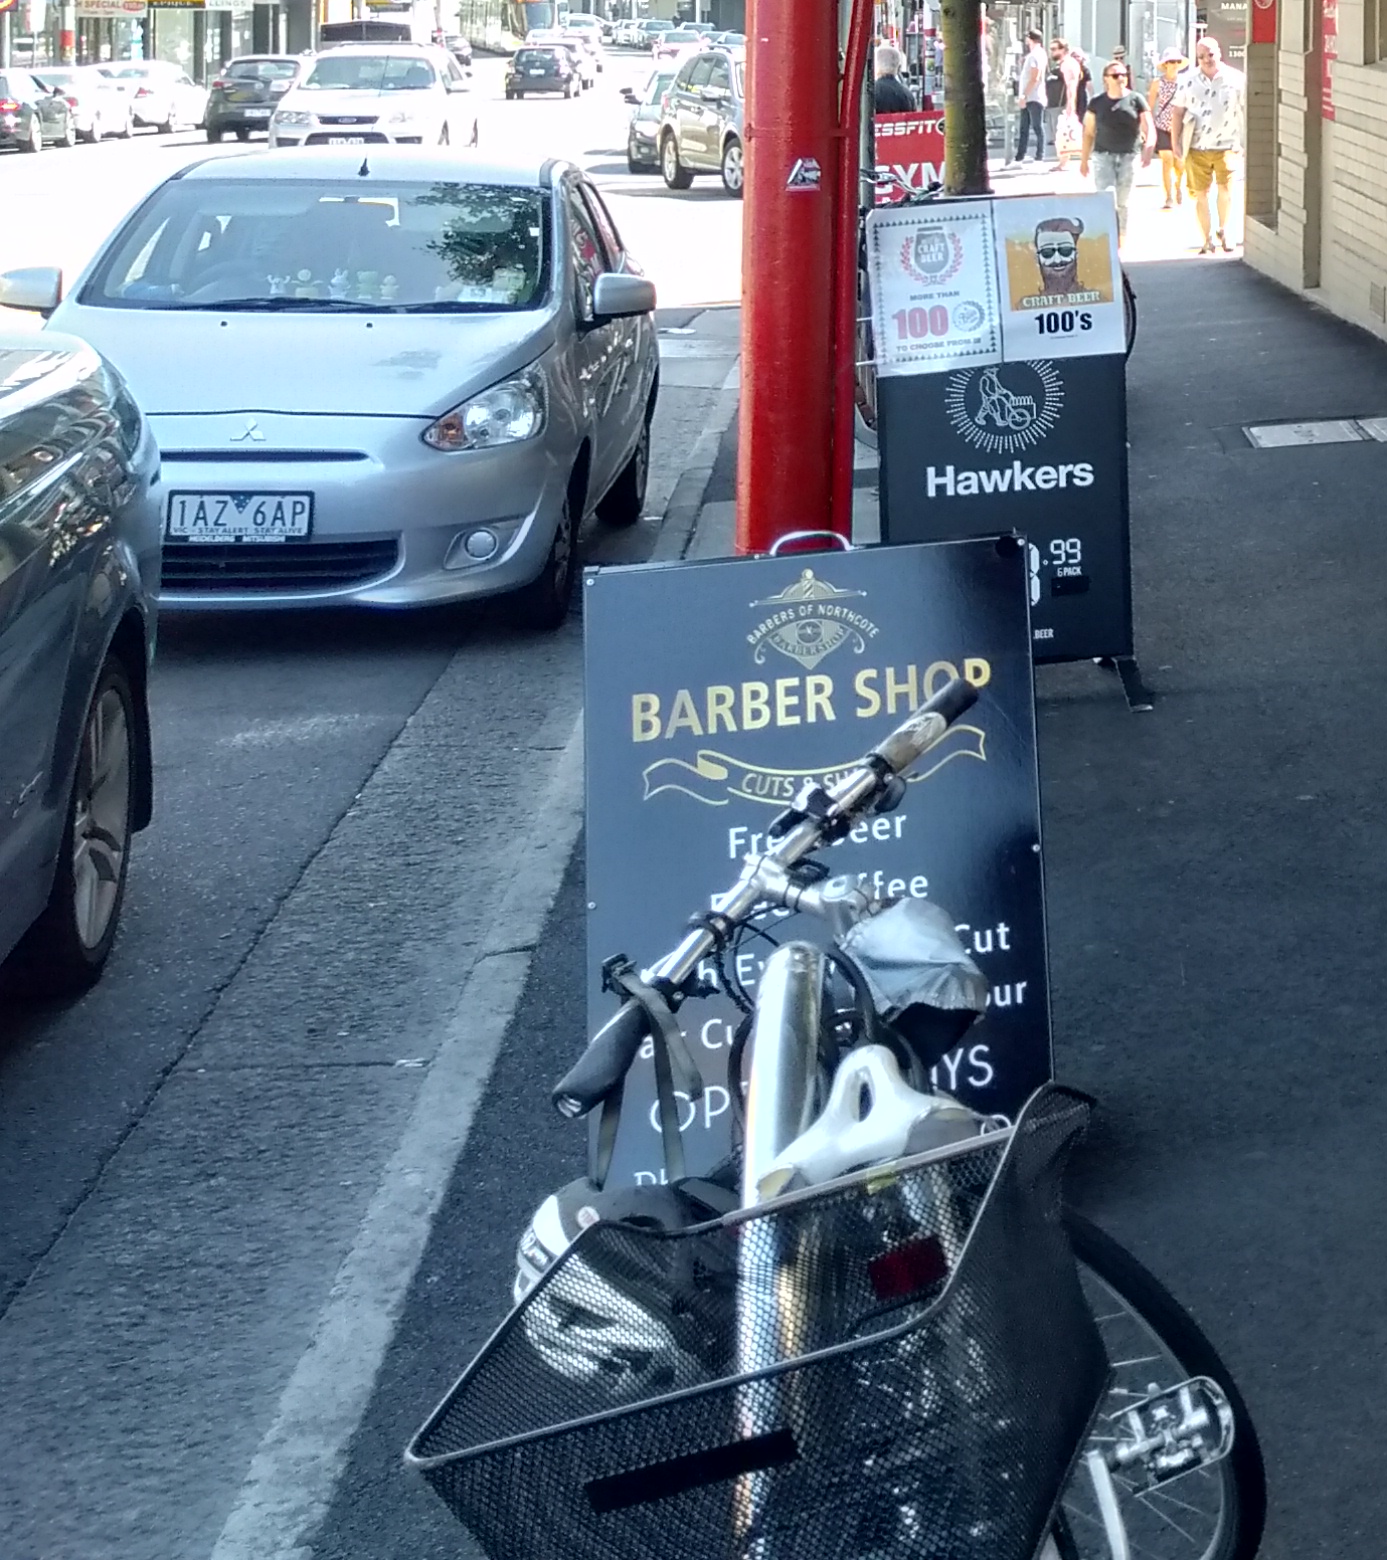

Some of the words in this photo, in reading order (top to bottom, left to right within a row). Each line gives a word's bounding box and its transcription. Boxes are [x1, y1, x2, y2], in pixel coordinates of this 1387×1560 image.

[84, 0, 121, 9] SPECIAL
[910, 293, 934, 301] MORE
[1022, 293, 1065, 308] CRAFT
[1068, 291, 1101, 303] BEER
[892, 304, 949, 340] 100
[1035, 310, 1093, 335] 100's
[926, 460, 1095, 497] Hawkers
[178, 500, 228, 527] 1AZ
[252, 500, 306, 527] 6AP
[746, 608, 795, 645] BARBERS
[799, 604, 814, 617] OF
[818, 604, 880, 639] NORTHCOTE
[632, 673, 836, 743] BARBER
[741, 772, 794, 797] CUTS
